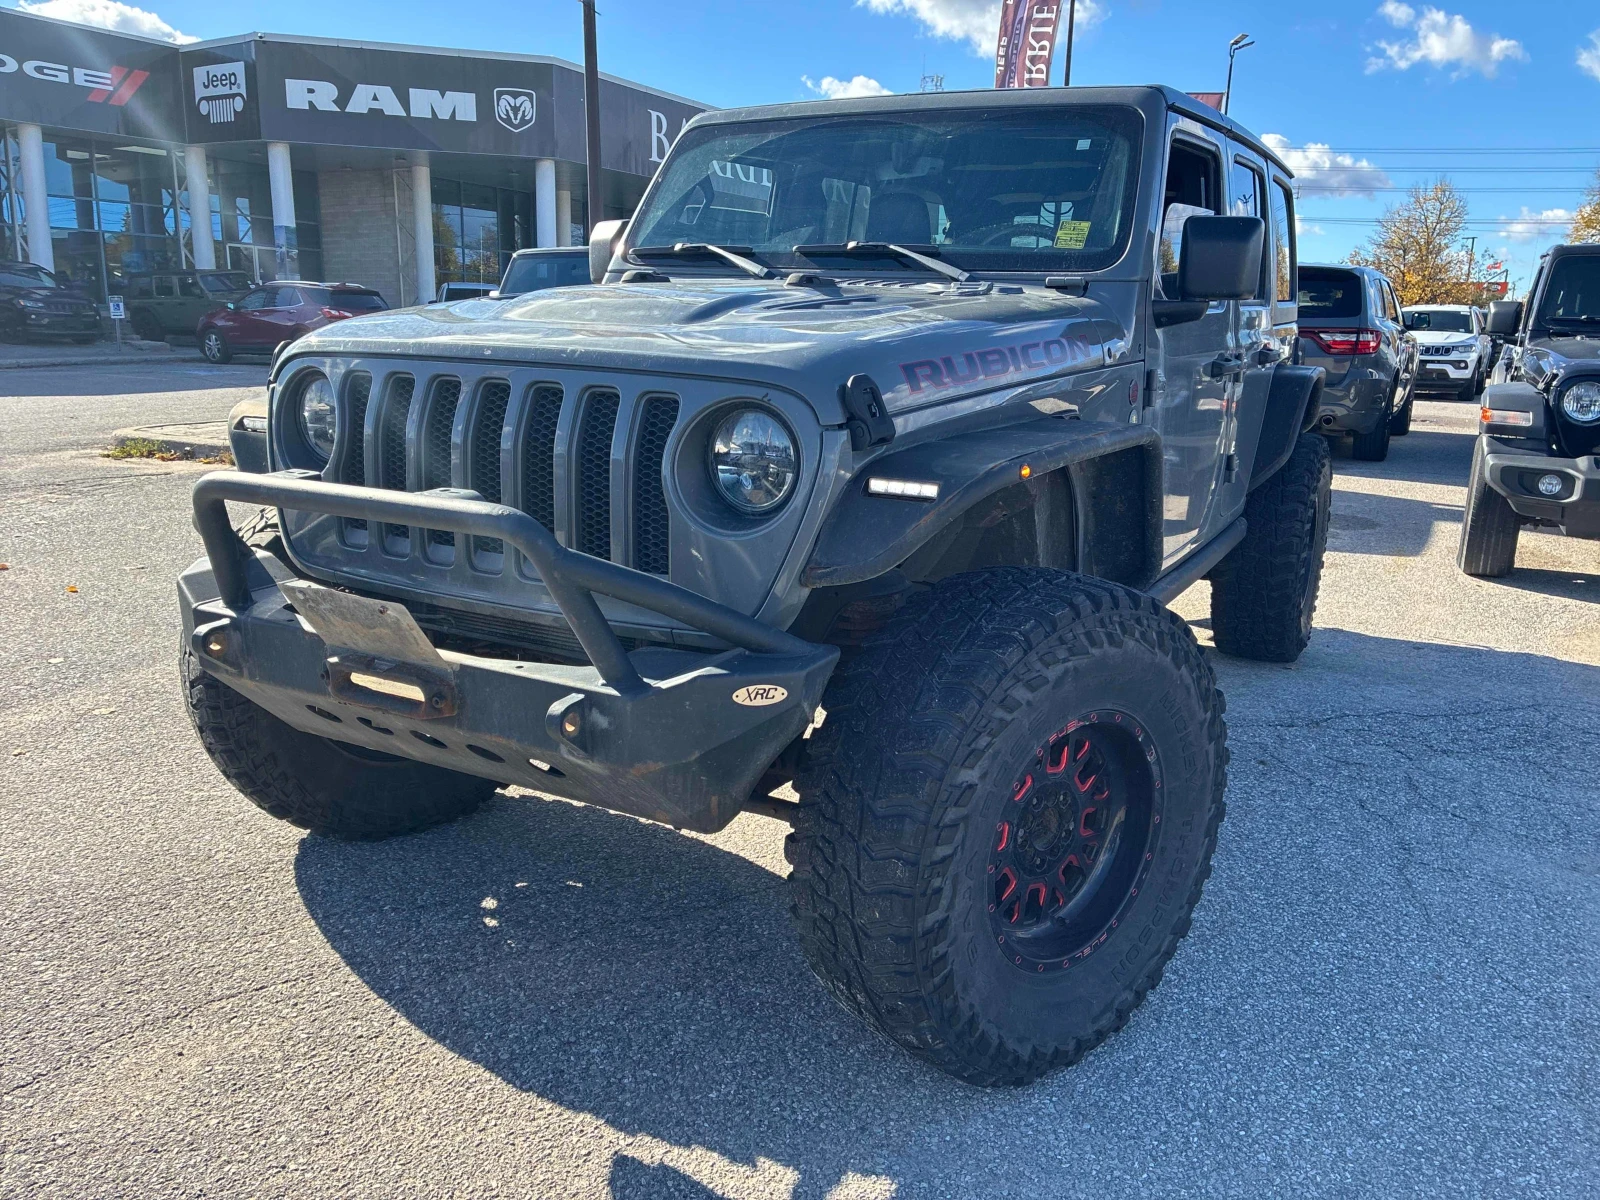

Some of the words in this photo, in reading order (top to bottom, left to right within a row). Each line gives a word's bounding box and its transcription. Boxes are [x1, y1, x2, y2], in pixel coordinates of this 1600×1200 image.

[203, 70, 238, 91] Jeep
[285, 79, 477, 122] RAM
[899, 334, 1092, 395] RUBICON
[742, 687, 778, 702] XRC
